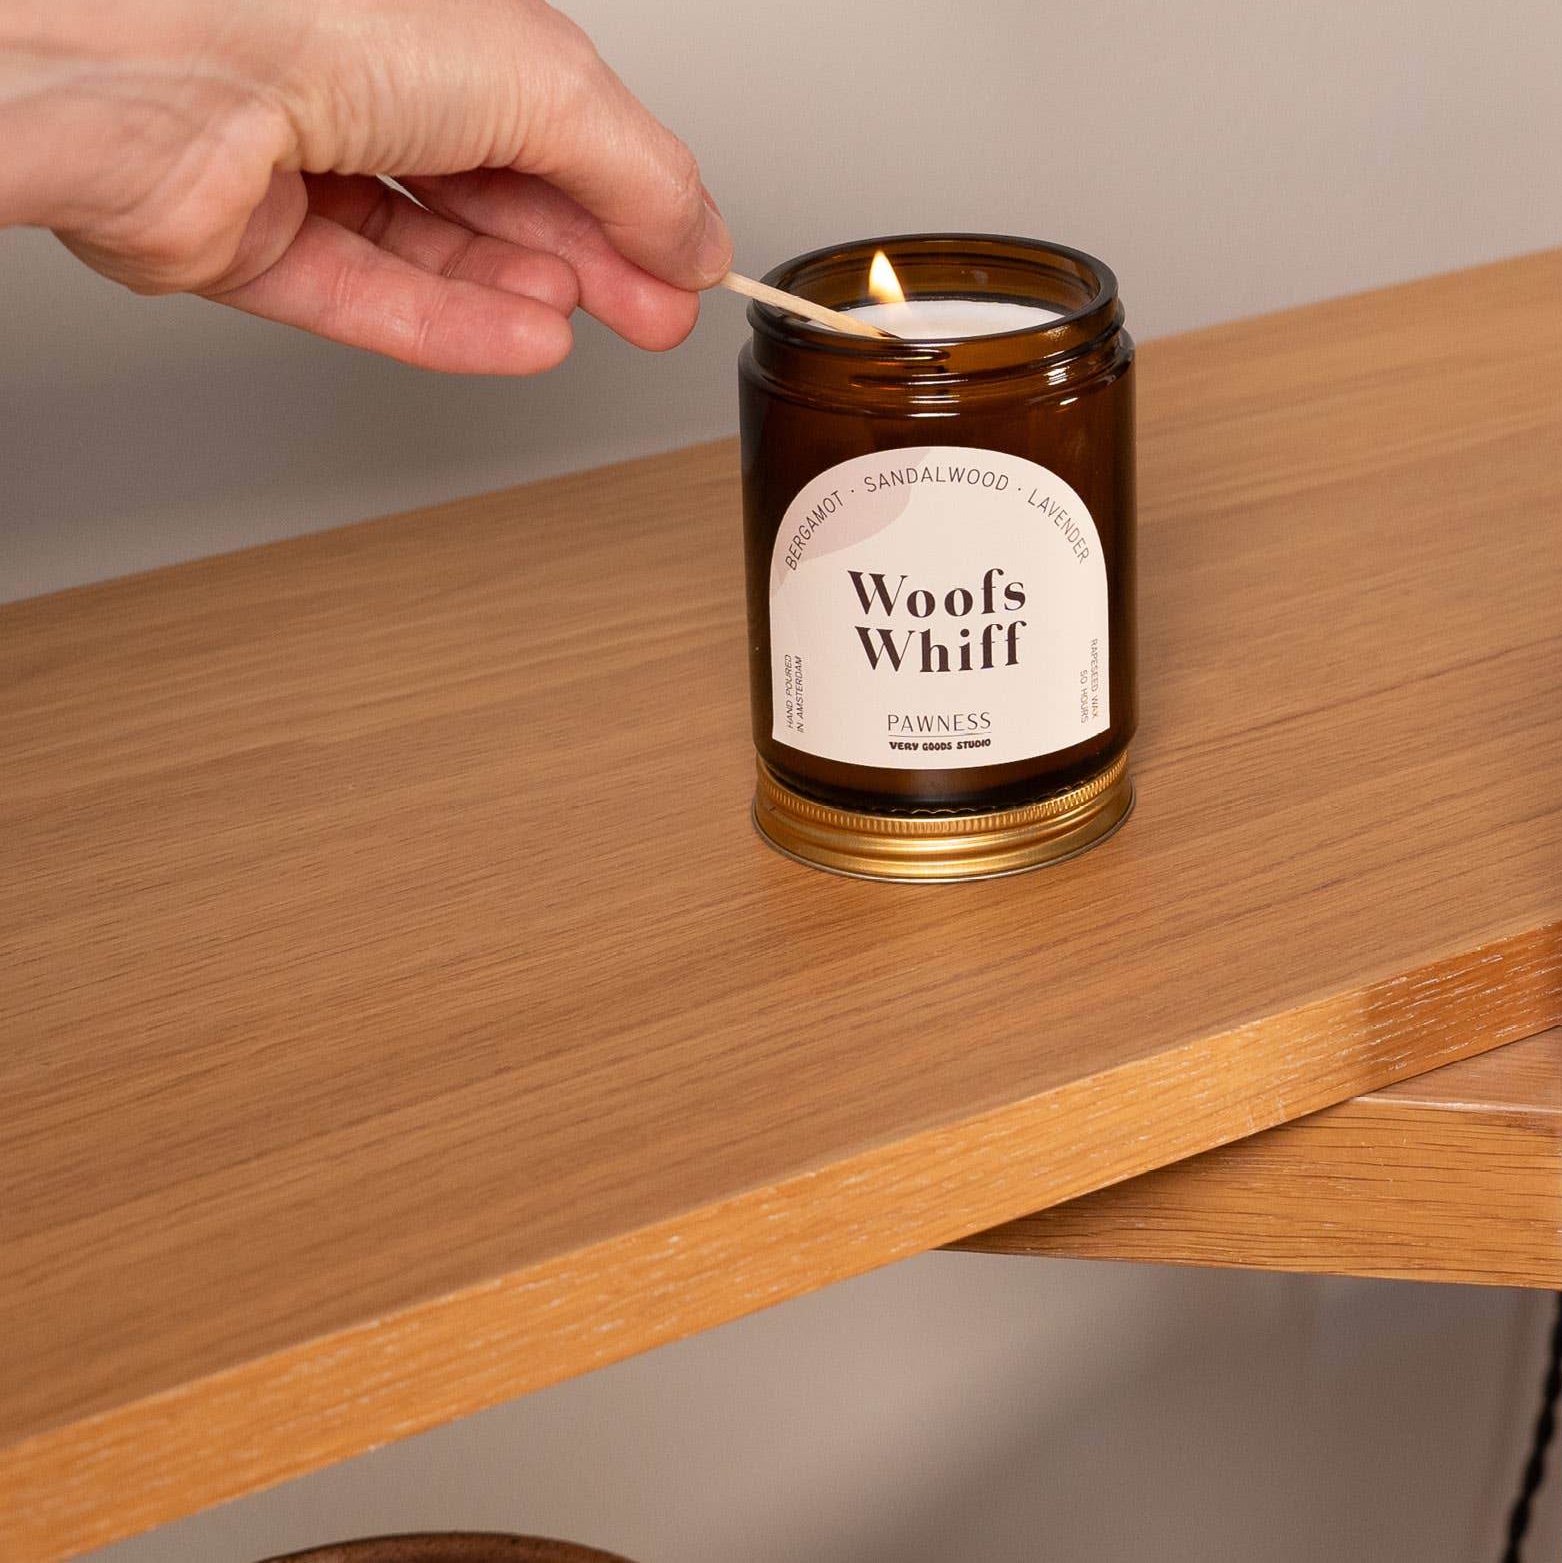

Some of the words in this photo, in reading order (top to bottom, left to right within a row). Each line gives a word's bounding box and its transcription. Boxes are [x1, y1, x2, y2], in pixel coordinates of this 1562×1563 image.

[785, 490, 844, 571] BERGAMOT
[864, 466, 1009, 492] SANDALWOOD
[1027, 488, 1089, 564] LAVENDER
[847, 568, 1026, 619] Woofs
[854, 620, 1027, 673] Whiff
[1090, 638, 1099, 692] RAPESEED
[785, 653, 793, 697] POURED
[796, 656, 804, 720] AMSTERDAM
[786, 698, 795, 730] HAND
[888, 712, 991, 732] PAWNESS
[1080, 688, 1088, 723] HOURS
[1091, 694, 1099, 719] WAX
[797, 721, 805, 734] IN
[889, 741, 919, 750] VERY
[922, 741, 952, 750] GOODS
[957, 739, 991, 749] STUDIO
